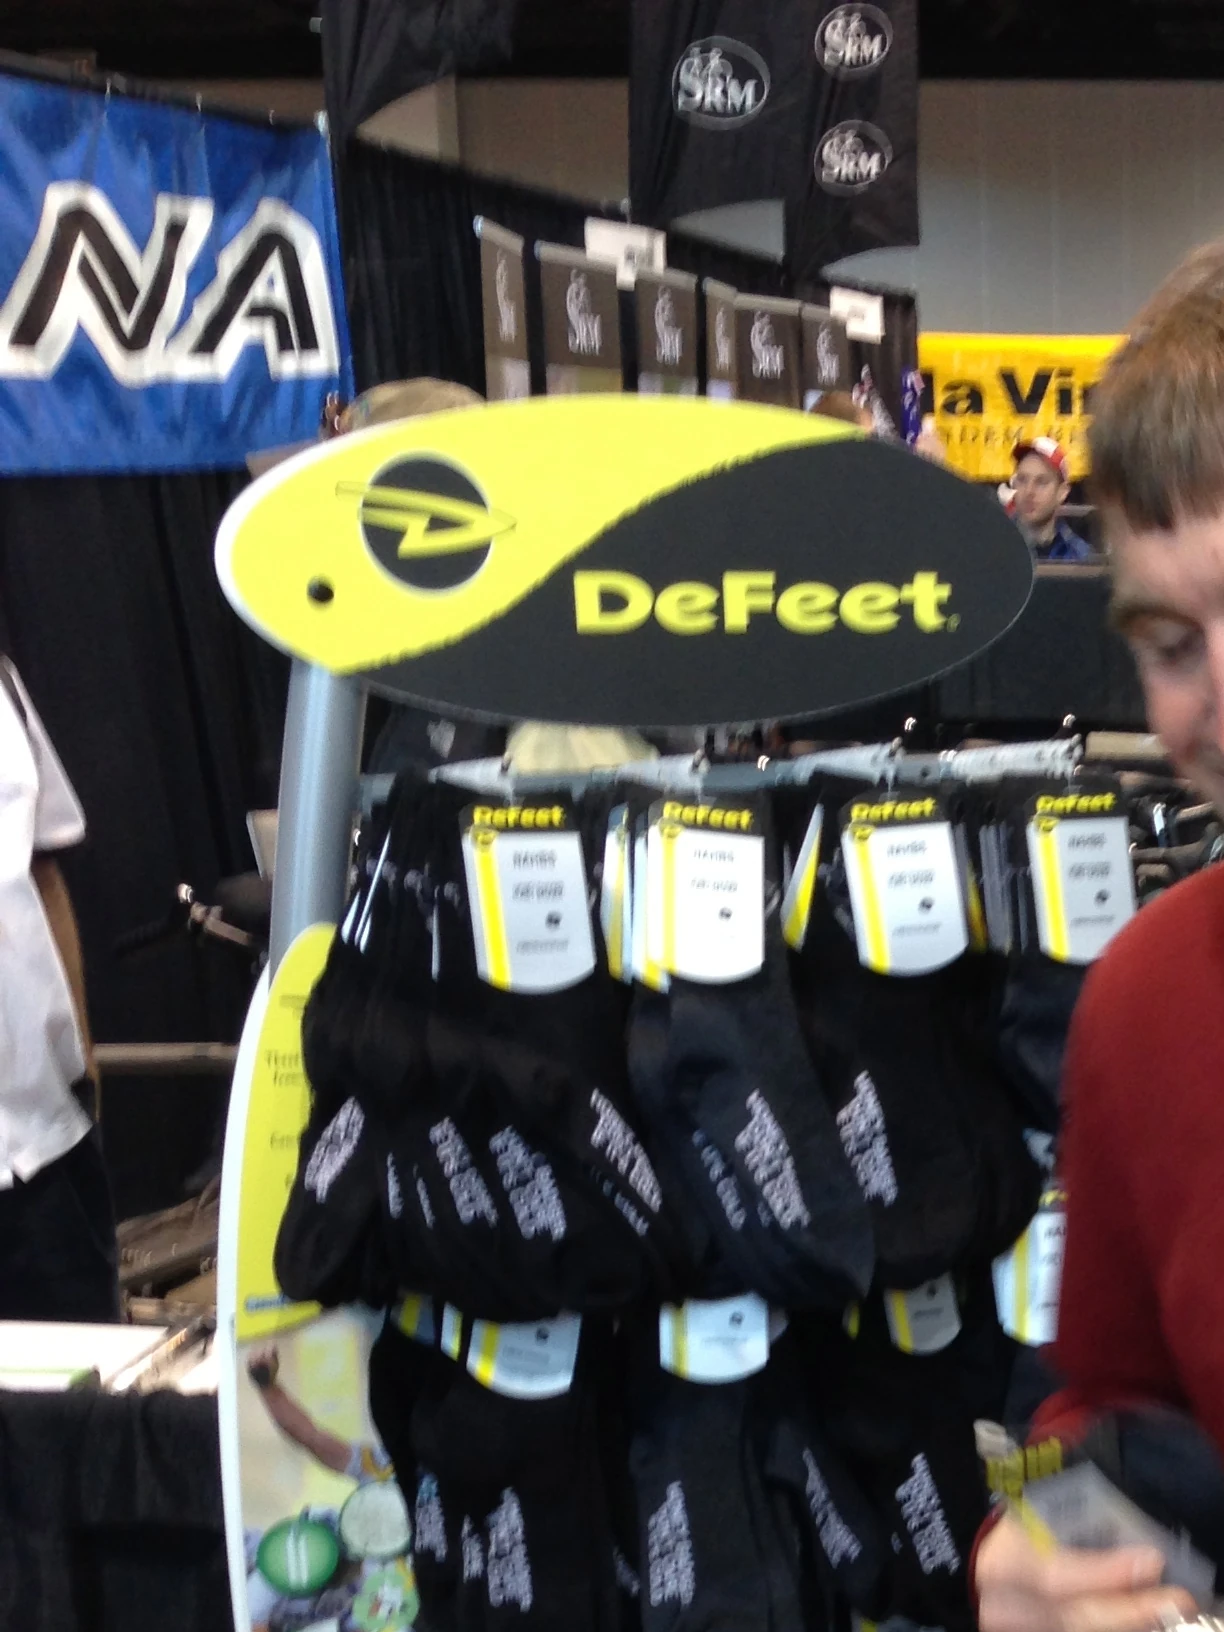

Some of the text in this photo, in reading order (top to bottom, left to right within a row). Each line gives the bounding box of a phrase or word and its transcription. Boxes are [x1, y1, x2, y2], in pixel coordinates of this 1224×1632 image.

[677, 54, 758, 113] SRM
[573, 568, 953, 636] DeFeet
[473, 805, 565, 829] DeFeet
[663, 801, 753, 830] DeFeet
